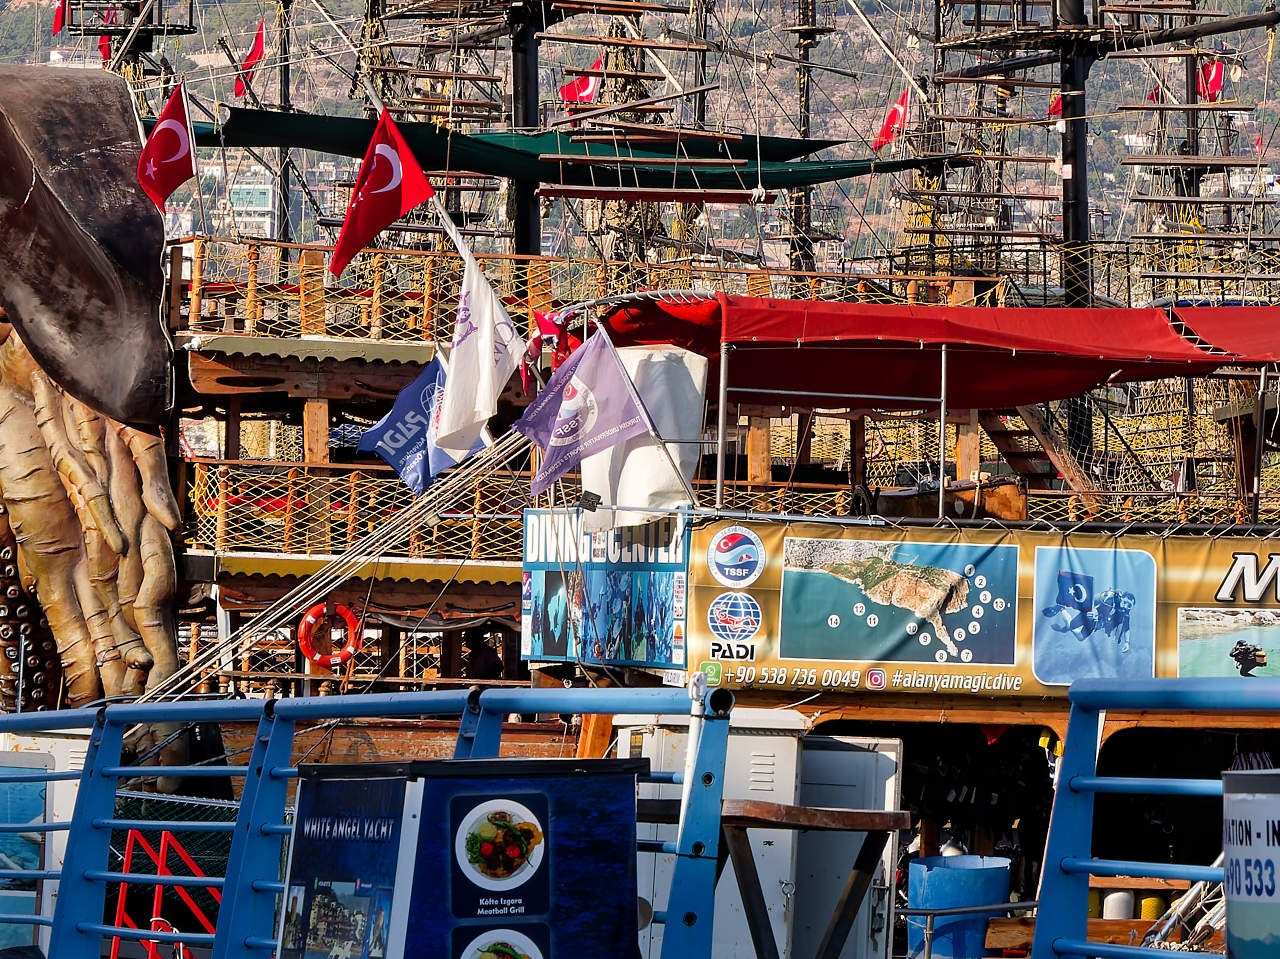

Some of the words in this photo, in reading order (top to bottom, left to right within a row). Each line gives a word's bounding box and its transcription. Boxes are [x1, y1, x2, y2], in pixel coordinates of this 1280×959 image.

[526, 514, 591, 563] DIVING
[723, 567, 750, 577] TSSF
[711, 642, 755, 660] PADI
[725, 666, 756, 684] +90
[758, 667, 787, 685] 538
[791, 668, 817, 686] 736
[821, 669, 861, 687] 0049
[891, 669, 1023, 692] #alanyamagicdive
[303, 816, 331, 839] WHITE
[331, 817, 361, 840] ANGEL
[363, 817, 395, 840] YACHT
[1244, 857, 1276, 897] 533
[477, 907, 508, 915] Meatball
[509, 906, 525, 914] Grill
